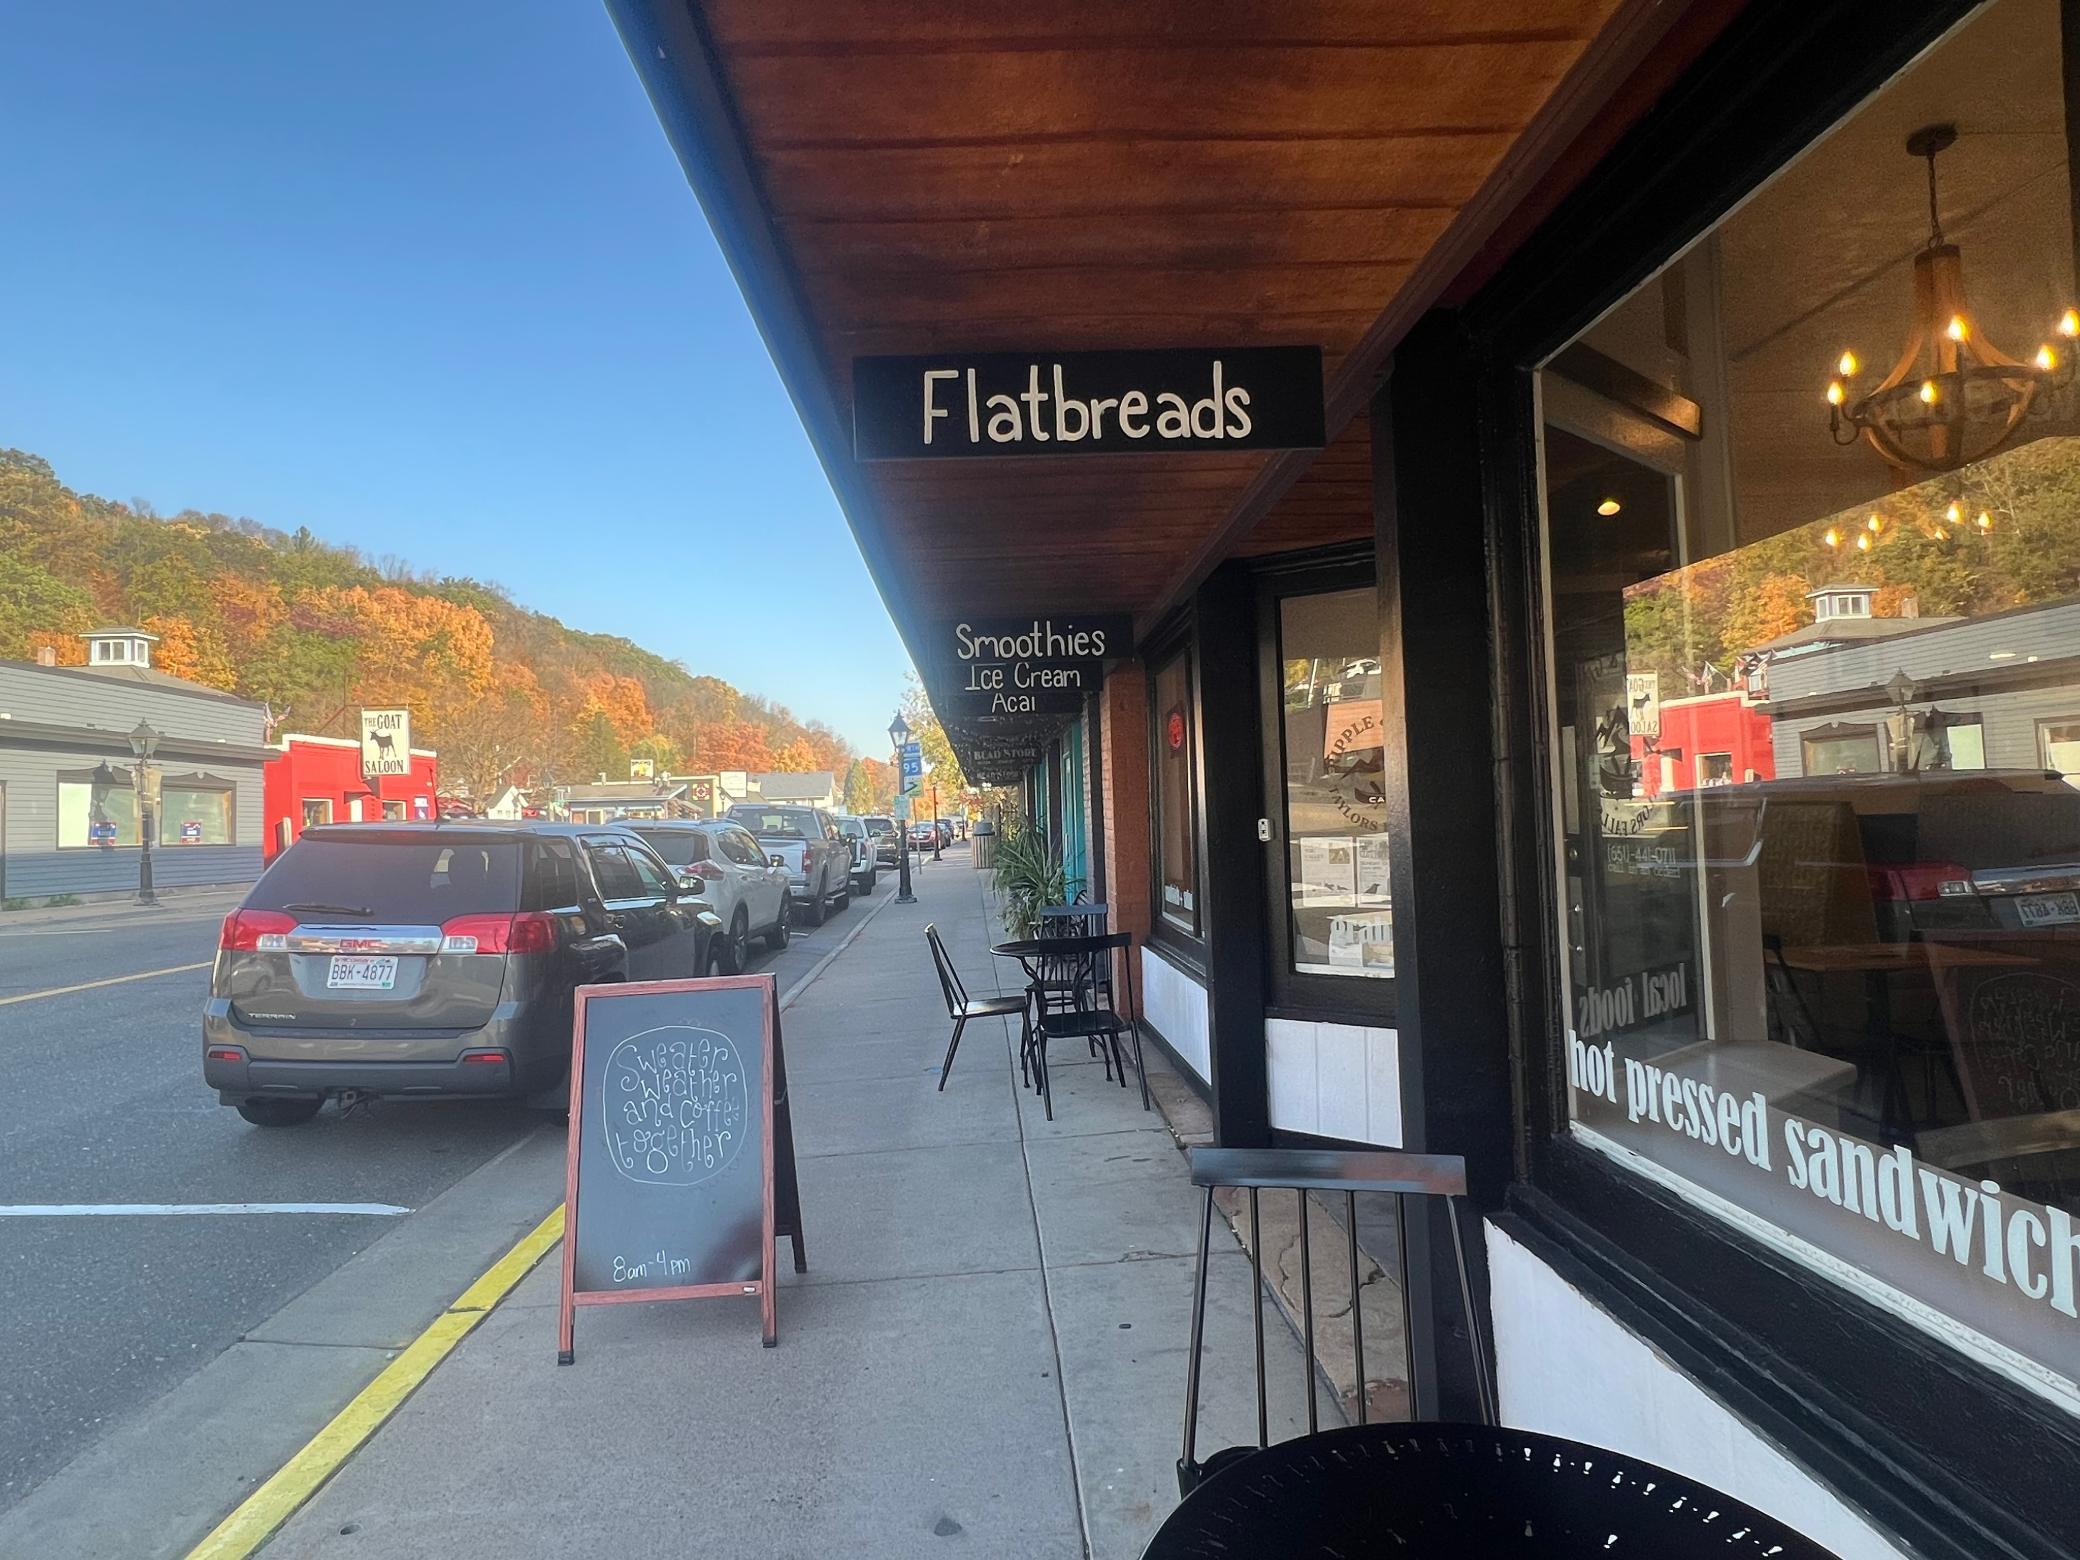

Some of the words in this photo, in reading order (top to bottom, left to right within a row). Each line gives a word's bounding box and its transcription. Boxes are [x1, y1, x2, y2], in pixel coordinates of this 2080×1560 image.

[923, 360, 1253, 444] Flatbreads
[955, 620, 1106, 660] Smoothies
[965, 663, 1004, 691] Ice
[1014, 661, 1081, 689] Cream
[991, 693, 1036, 713] Acai
[364, 717, 376, 727] THE
[377, 714, 402, 729] GOAT
[365, 760, 404, 773] SALOON
[903, 762, 919, 773] 95
[1329, 787, 1379, 832] TAYLORS
[340, 939, 382, 948] GMC
[331, 964, 393, 981] BBK-4877
[616, 1038, 729, 1091] Sweater
[623, 1092, 674, 1126] and
[1568, 1029, 1617, 1104] hot
[1625, 1056, 1772, 1172] pressed
[616, 1124, 731, 1173] together
